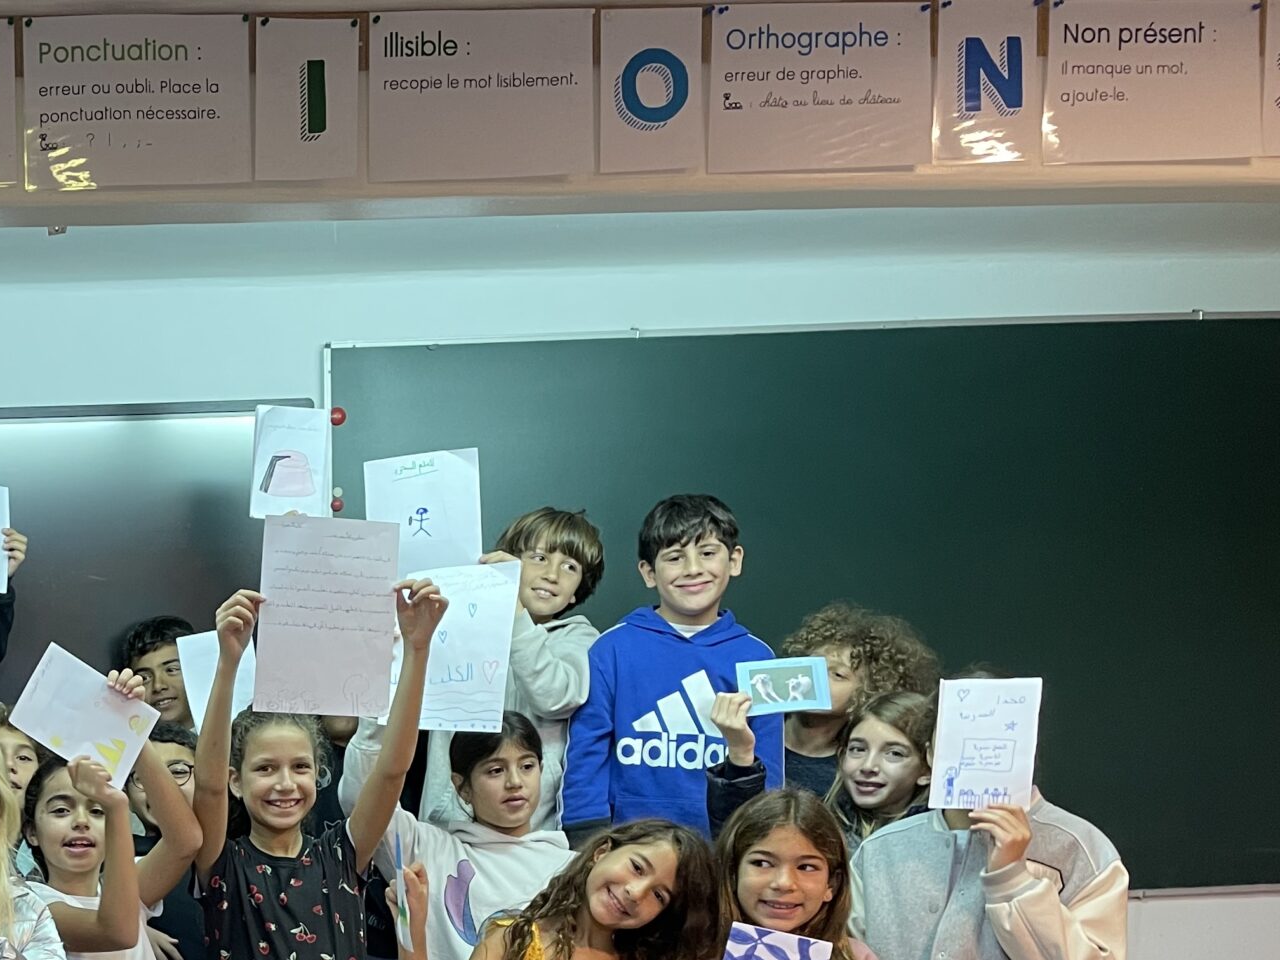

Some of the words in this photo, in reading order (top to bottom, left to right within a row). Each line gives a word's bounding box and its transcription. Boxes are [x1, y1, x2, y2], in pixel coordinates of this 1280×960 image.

[383, 30, 458, 58] Illisible
[726, 22, 889, 56] Orthographe
[1063, 23, 1111, 44] Non
[1118, 21, 1206, 51] présent
[38, 37, 189, 64] Ponctuation
[383, 76, 443, 94] recopie
[447, 73, 460, 89] le
[463, 75, 492, 89] mot
[496, 72, 579, 88] lisiblement.
[724, 70, 771, 83] erreur
[775, 67, 796, 81] de
[800, 64, 863, 85] graphie.
[956, 36, 1024, 120] N
[1061, 60, 1068, 75] Il
[1071, 63, 1132, 79] manque
[1136, 63, 1153, 75] un
[38, 83, 87, 97] erreur
[91, 83, 111, 95] ou
[115, 78, 156, 95] oubli.
[160, 79, 202, 95] Place
[205, 78, 220, 94] la
[299, 58, 327, 143] I
[613, 47, 689, 133] O
[792, 99, 809, 107] au
[813, 90, 835, 106] lieu
[839, 94, 854, 105] de
[857, 89, 902, 105] château
[1060, 86, 1129, 107] ajoute-le.
[39, 106, 132, 128] ponctuation
[136, 105, 221, 121] nécessaire.
[616, 731, 729, 770] adida
